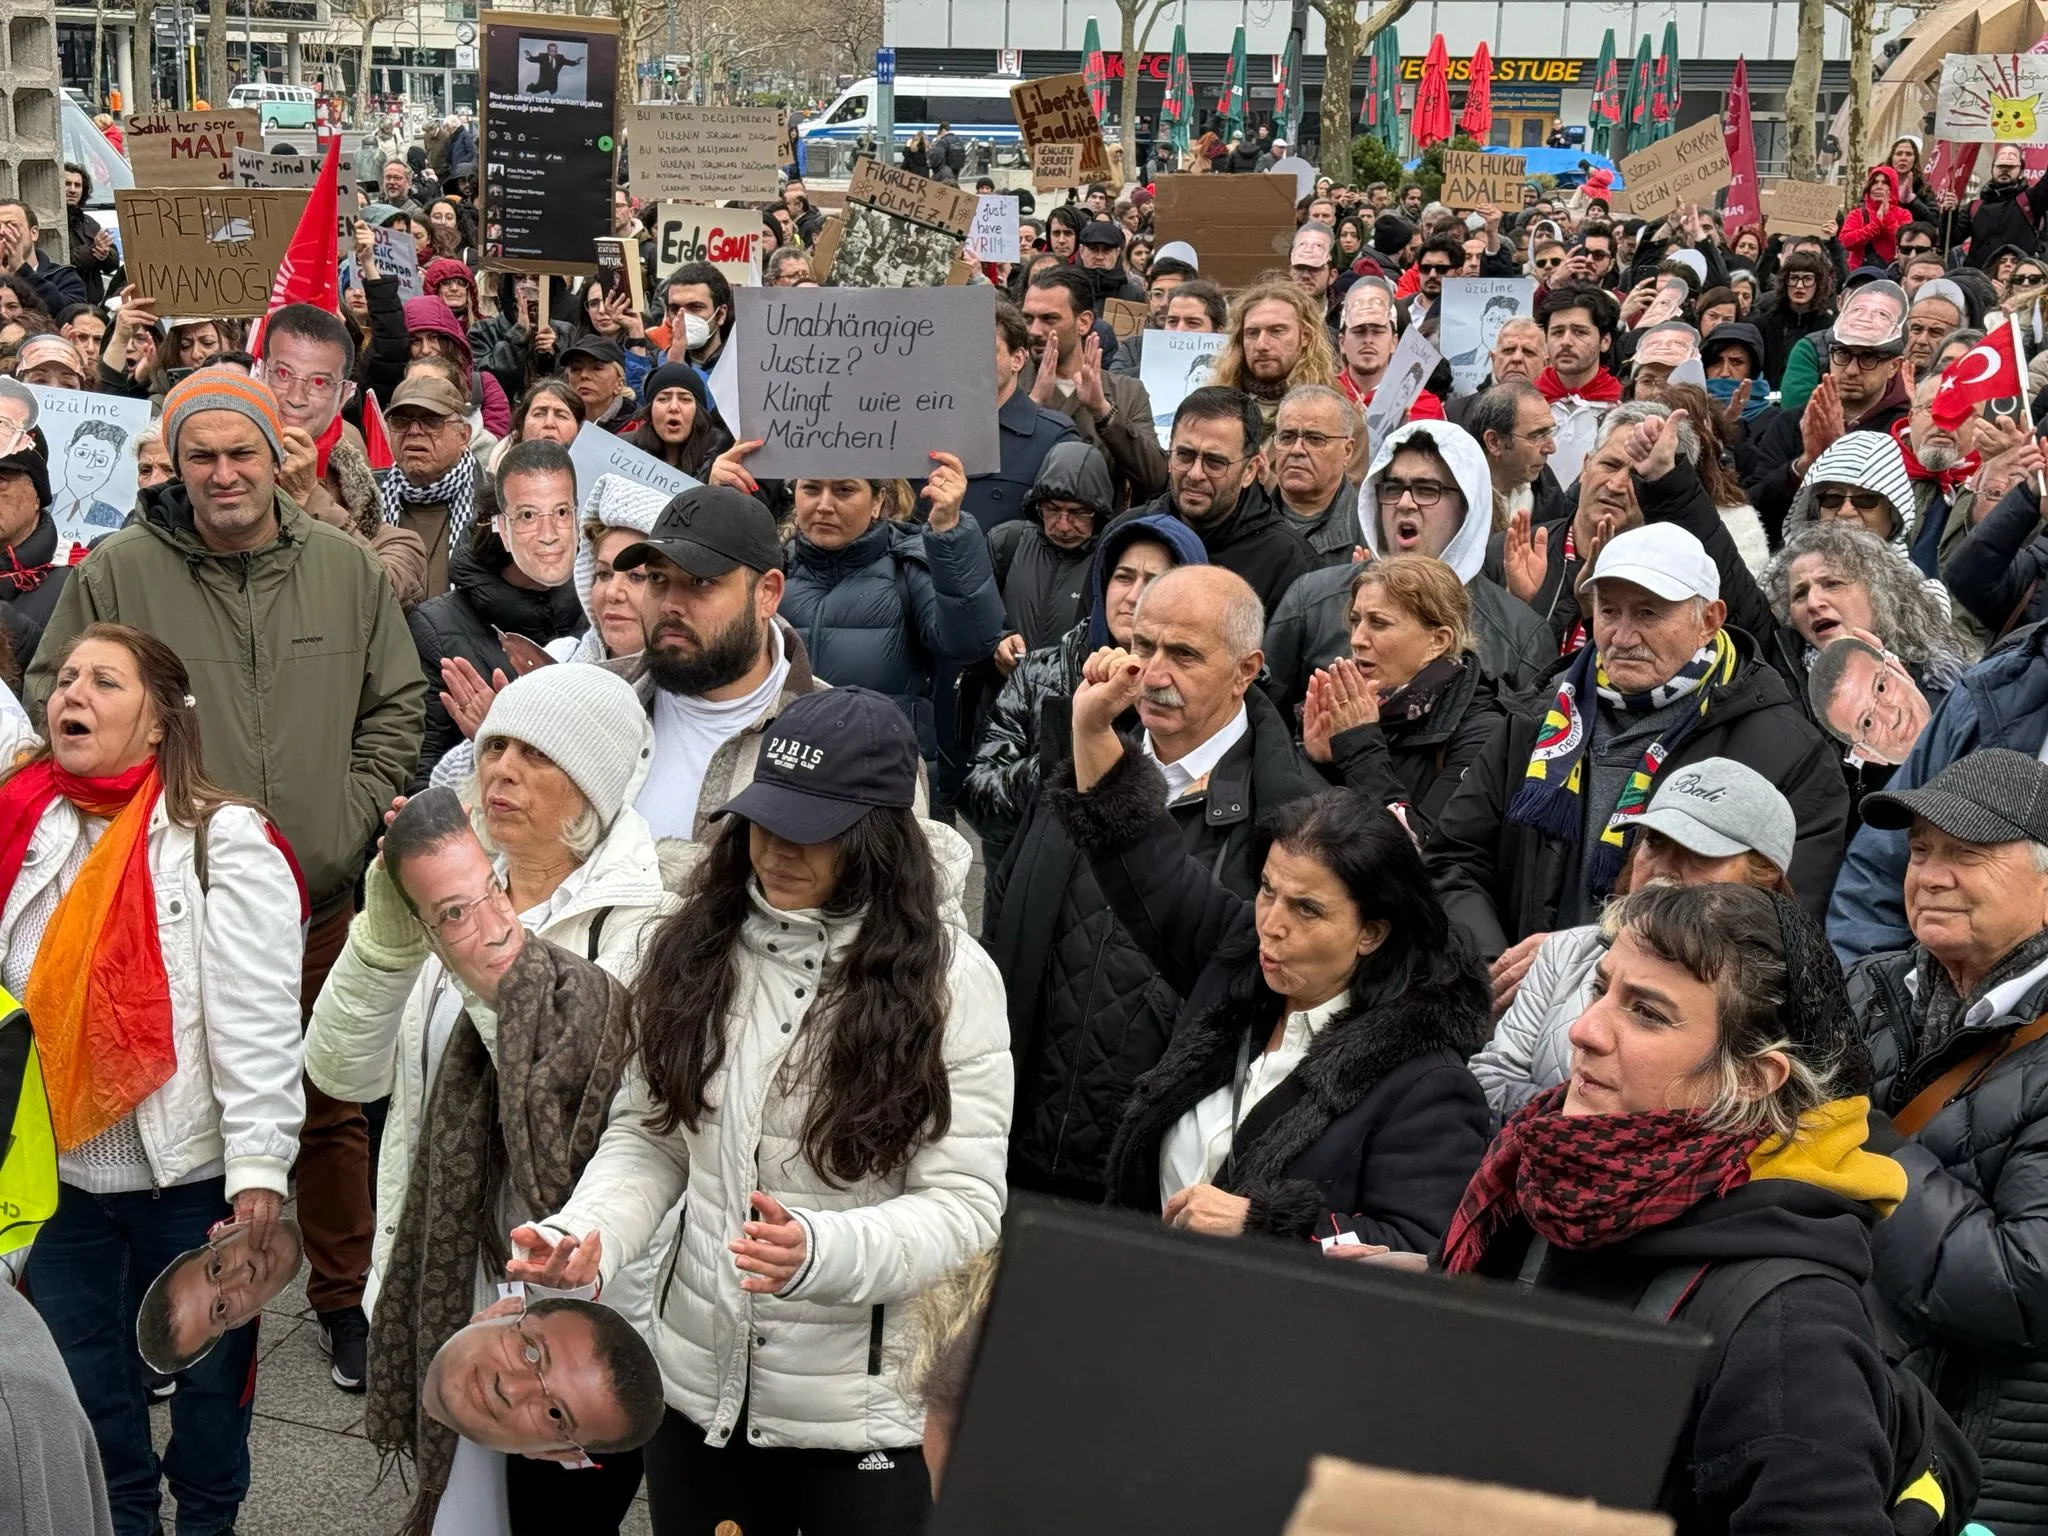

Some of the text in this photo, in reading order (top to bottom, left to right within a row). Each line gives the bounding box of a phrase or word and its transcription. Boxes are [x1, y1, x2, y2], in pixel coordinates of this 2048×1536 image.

[1674, 126, 1721, 165] KORKAN
[270, 160, 305, 174] sind
[1444, 151, 1527, 177] HAK HUKUK
[1697, 155, 1731, 182] OLSUN
[1445, 175, 1524, 204] ADALET
[122, 196, 280, 240] FREIHEIT
[982, 200, 1008, 222] just
[977, 220, 1002, 235] have
[1465, 280, 1515, 294] üzülme
[765, 302, 936, 356] Unabhängige
[760, 343, 863, 377] Justiz?
[44, 394, 121, 418] üzülme
[762, 381, 956, 428] Klingt wie ein
[764, 418, 899, 451] Märchen!
[609, 447, 681, 495] üzülme
[767, 737, 825, 765] PARIS
[1668, 773, 1727, 803] Bali
[857, 1461, 896, 1471] adidas
